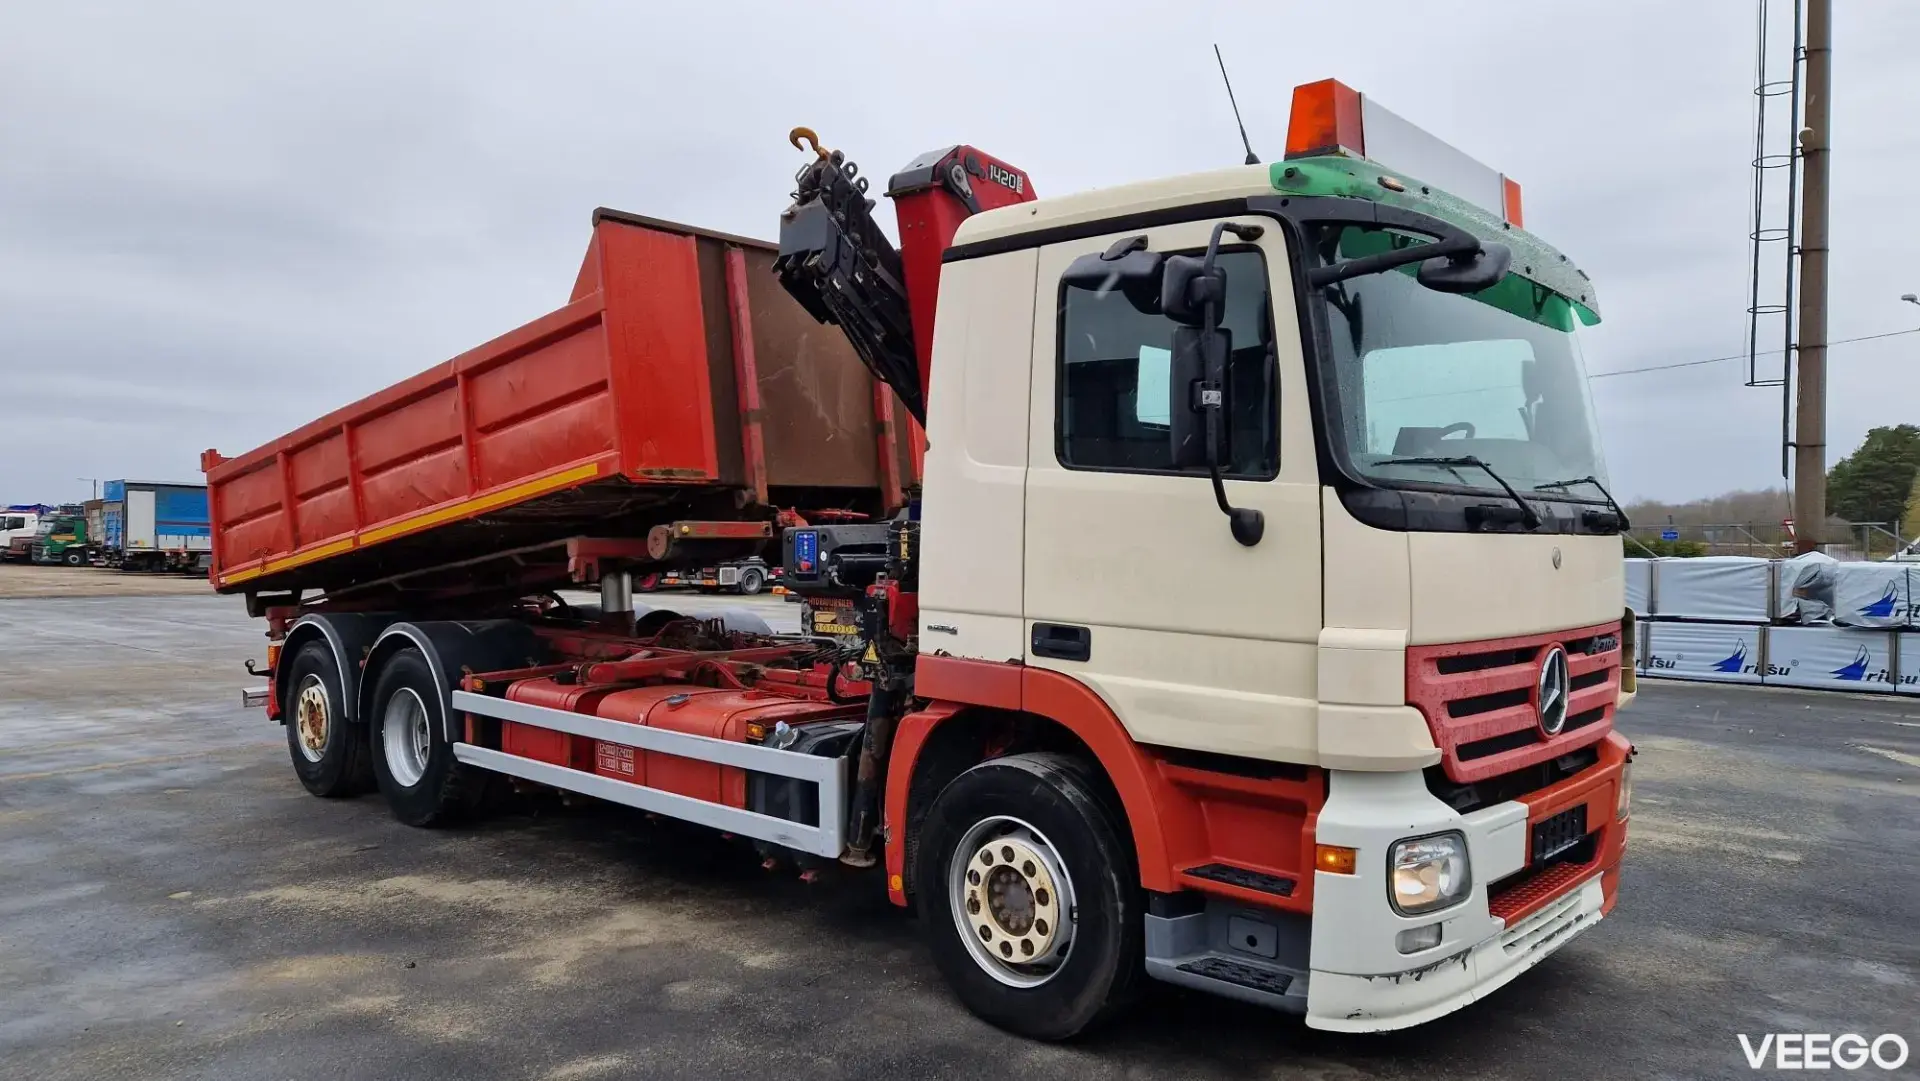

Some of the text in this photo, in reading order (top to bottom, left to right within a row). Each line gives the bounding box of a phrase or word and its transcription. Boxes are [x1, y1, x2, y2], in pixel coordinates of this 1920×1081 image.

[990, 164, 1016, 189] 1420
[1635, 655, 1676, 669] rtsu
[1743, 660, 1791, 676] risu
